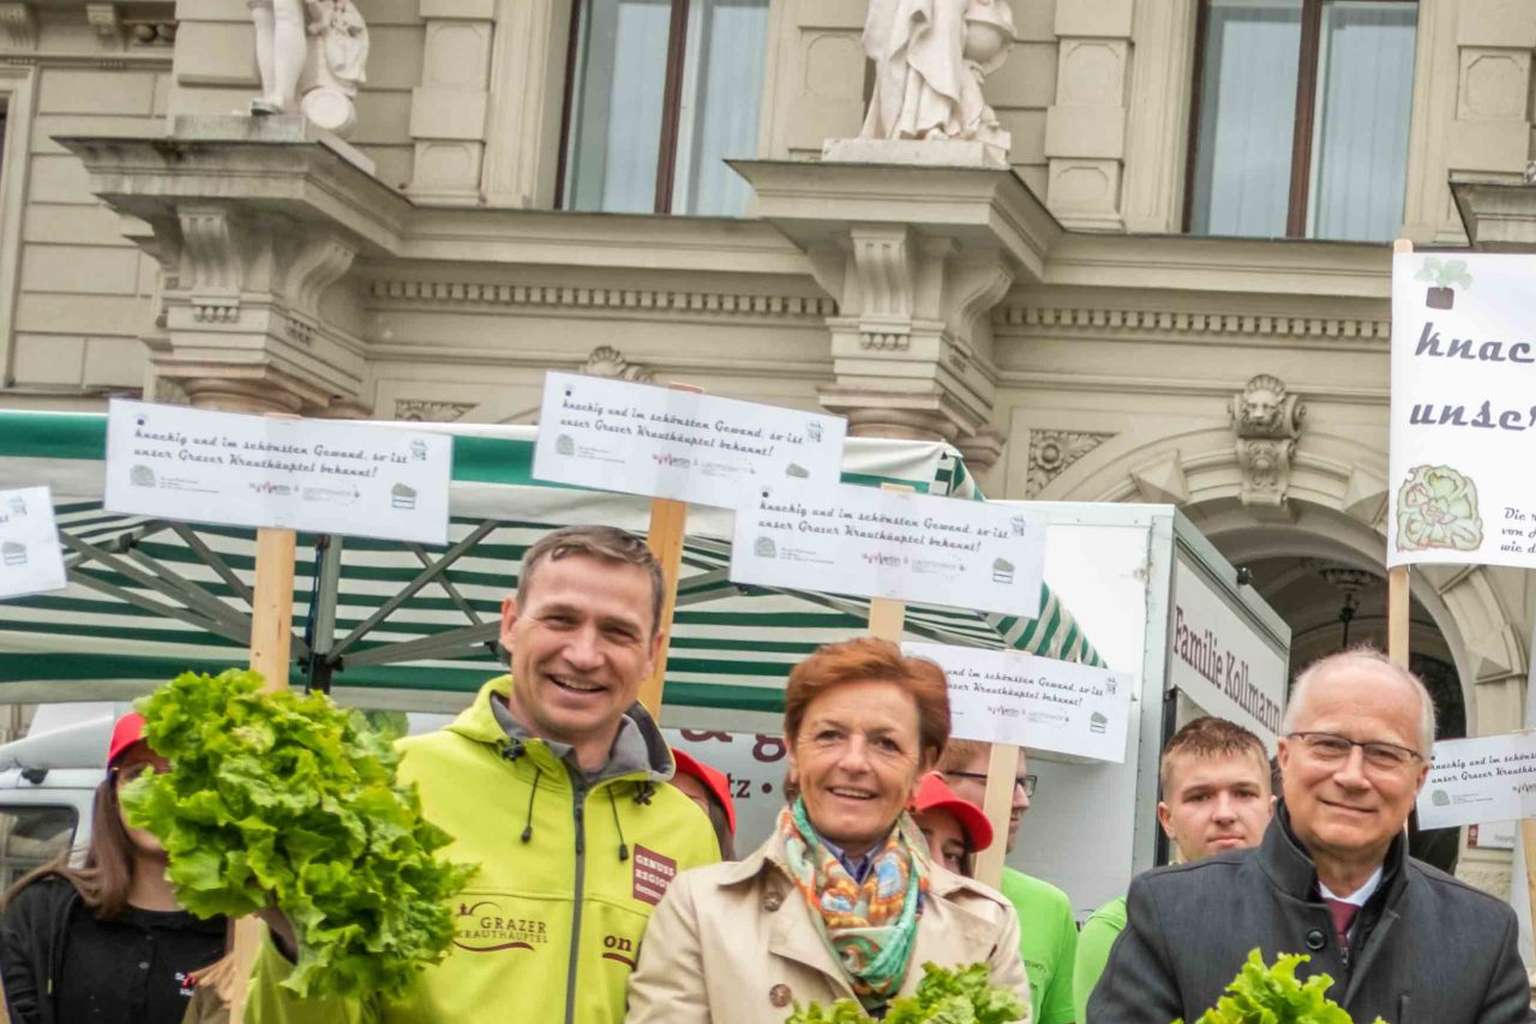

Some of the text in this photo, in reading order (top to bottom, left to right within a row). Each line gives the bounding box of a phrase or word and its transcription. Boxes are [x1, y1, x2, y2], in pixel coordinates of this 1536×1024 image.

[1504, 508, 1526, 520] Die
[1501, 528, 1523, 536] von
[1500, 541, 1522, 552] wie
[1174, 606, 1281, 737] Familie Kollmann
[480, 917, 547, 932] GRAZER
